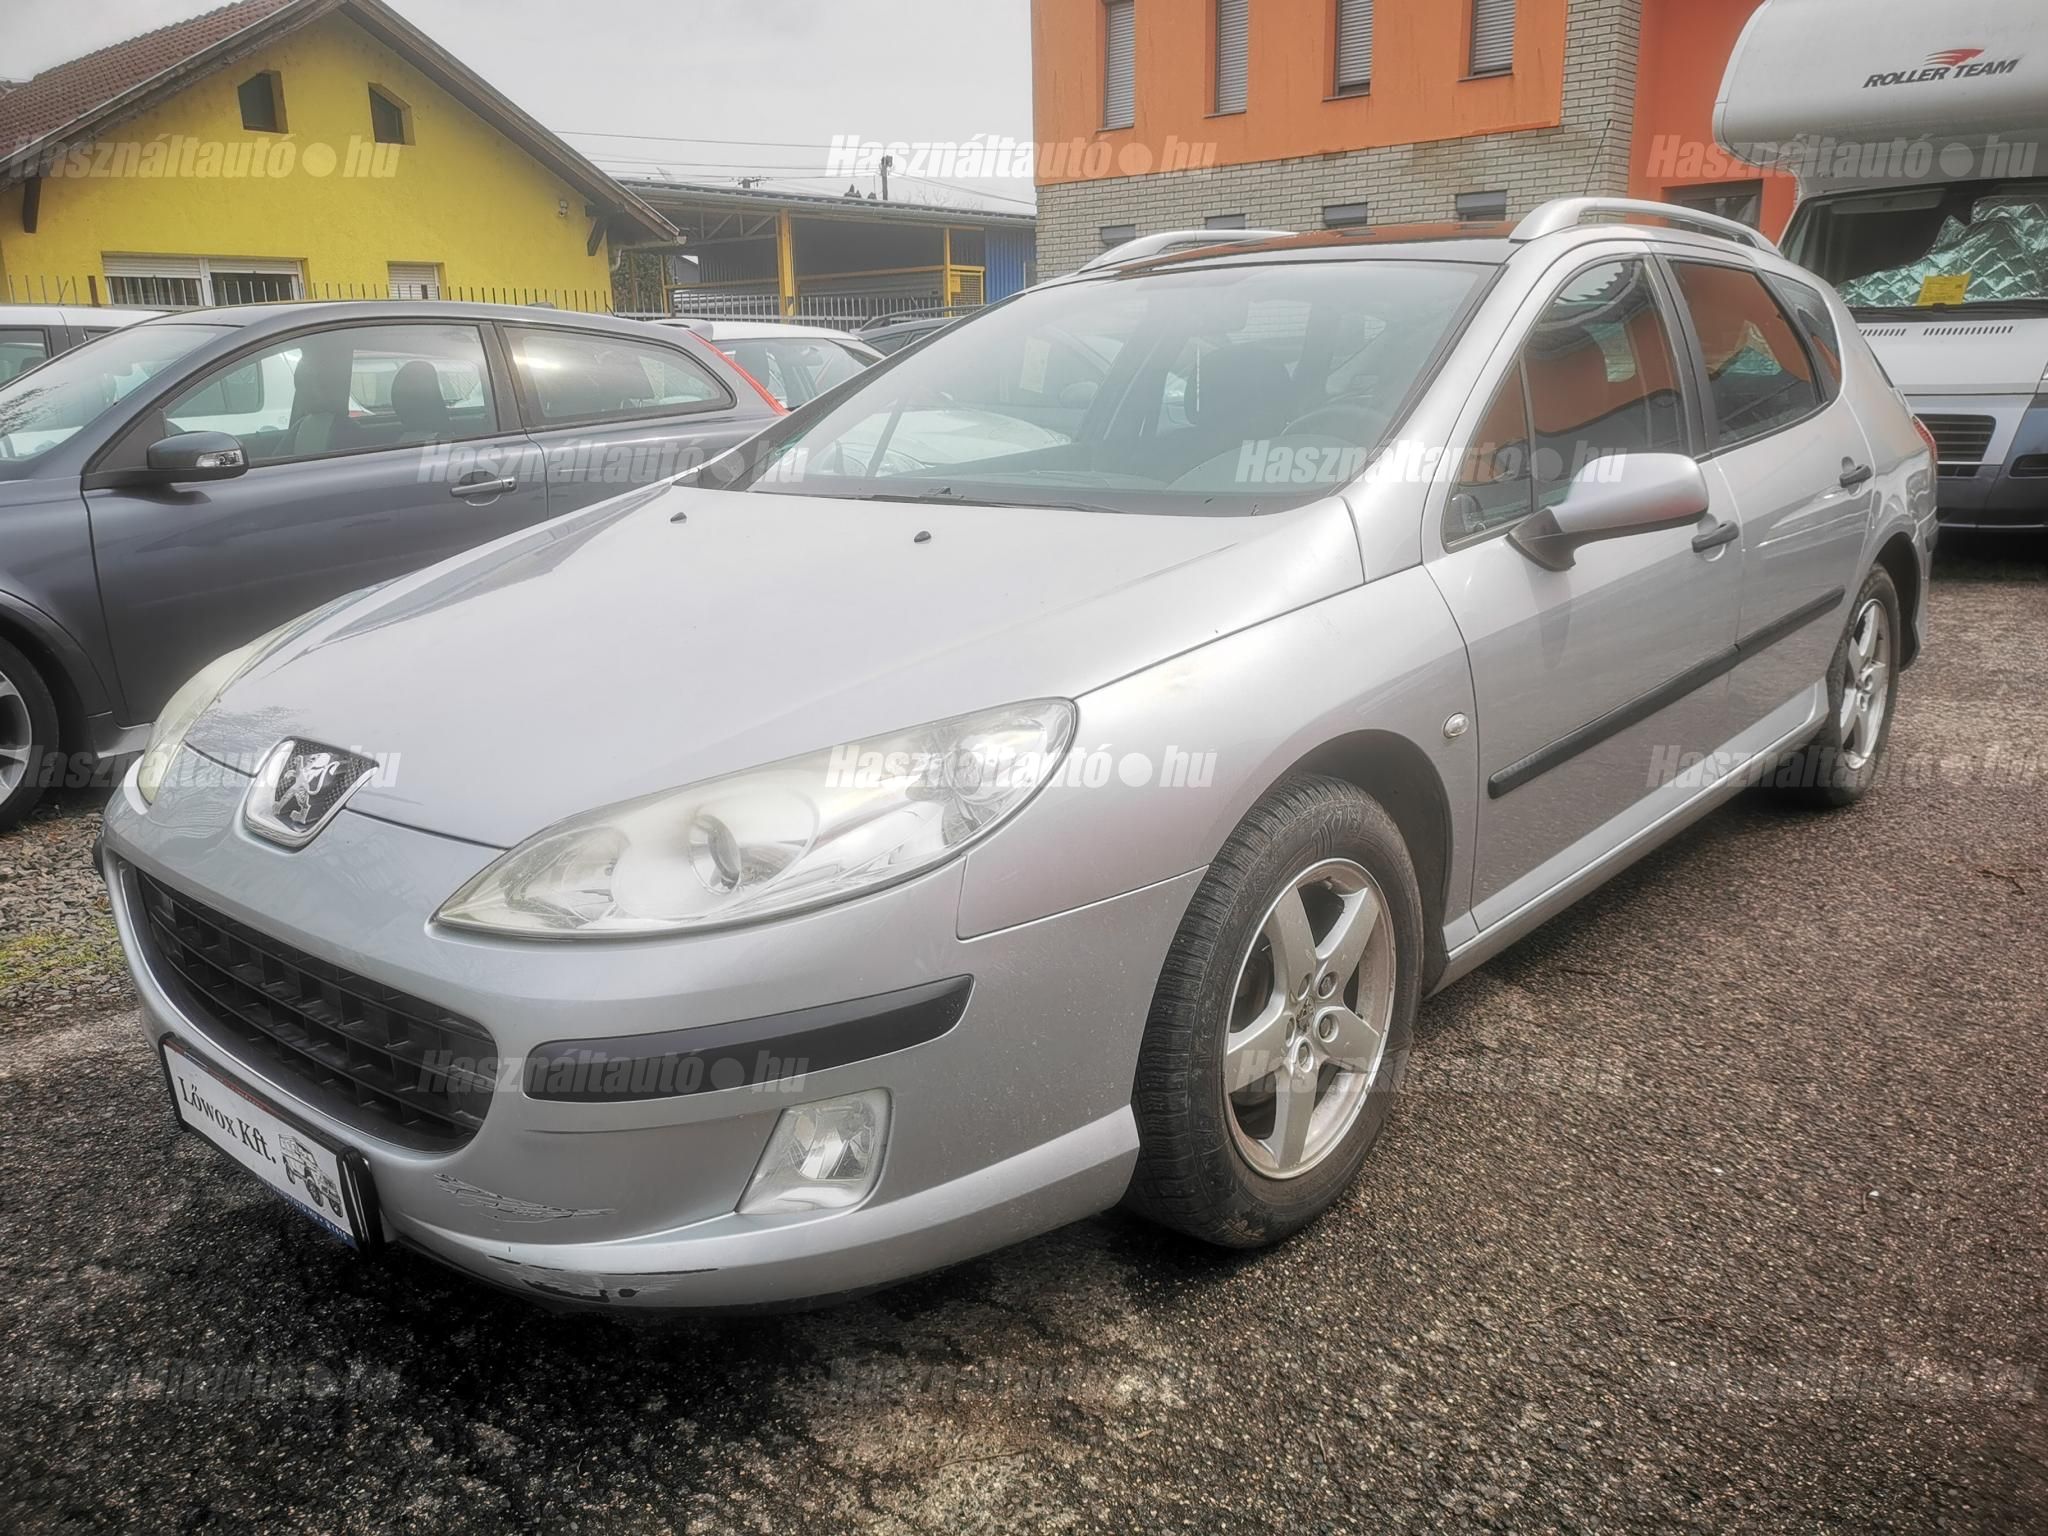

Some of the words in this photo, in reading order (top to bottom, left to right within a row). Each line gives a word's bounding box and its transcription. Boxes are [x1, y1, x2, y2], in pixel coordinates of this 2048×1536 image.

[1862, 66, 1951, 89] ROLLER
[1953, 58, 2020, 79] TEAM
[178, 1076, 238, 1139] Lőwox
[236, 1117, 277, 1164] Kft.
